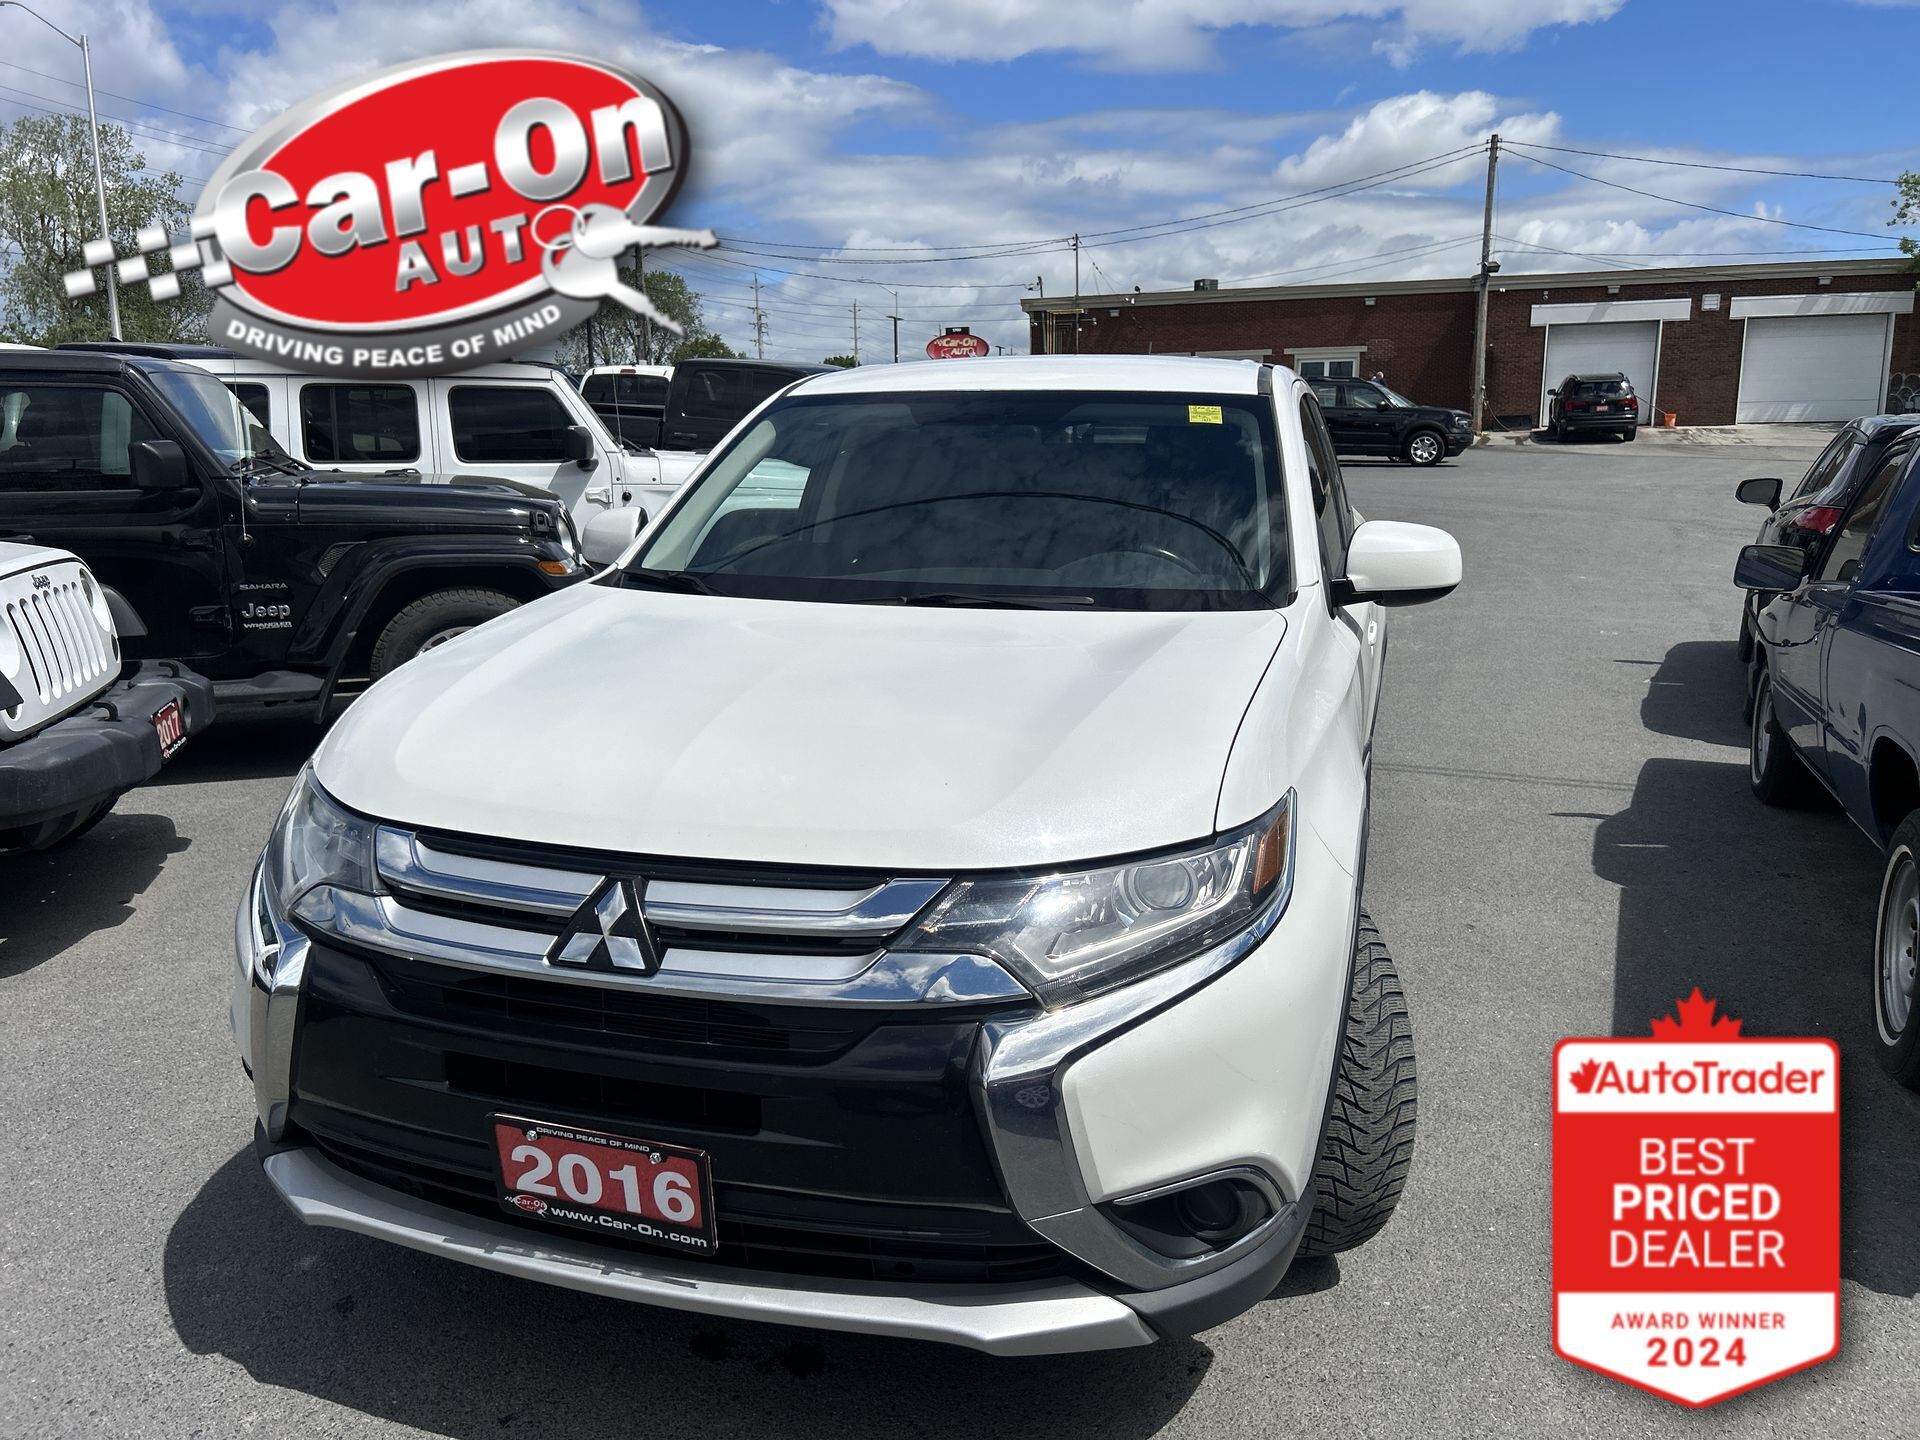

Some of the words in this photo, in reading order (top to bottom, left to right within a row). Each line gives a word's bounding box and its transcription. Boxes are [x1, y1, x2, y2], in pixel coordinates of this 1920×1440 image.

[942, 337, 978, 347] Car-On
[239, 583, 288, 591] SAHARA
[241, 602, 291, 620] Jeep
[156, 710, 181, 750] 2017
[536, 1126, 574, 1140] DRIVING
[576, 1133, 607, 1145] PEACE
[609, 1139, 622, 1148] OF
[624, 1142, 650, 1153] MIND
[511, 1144, 695, 1223] 2016
[551, 1206, 708, 1248] www.Car-On.com
